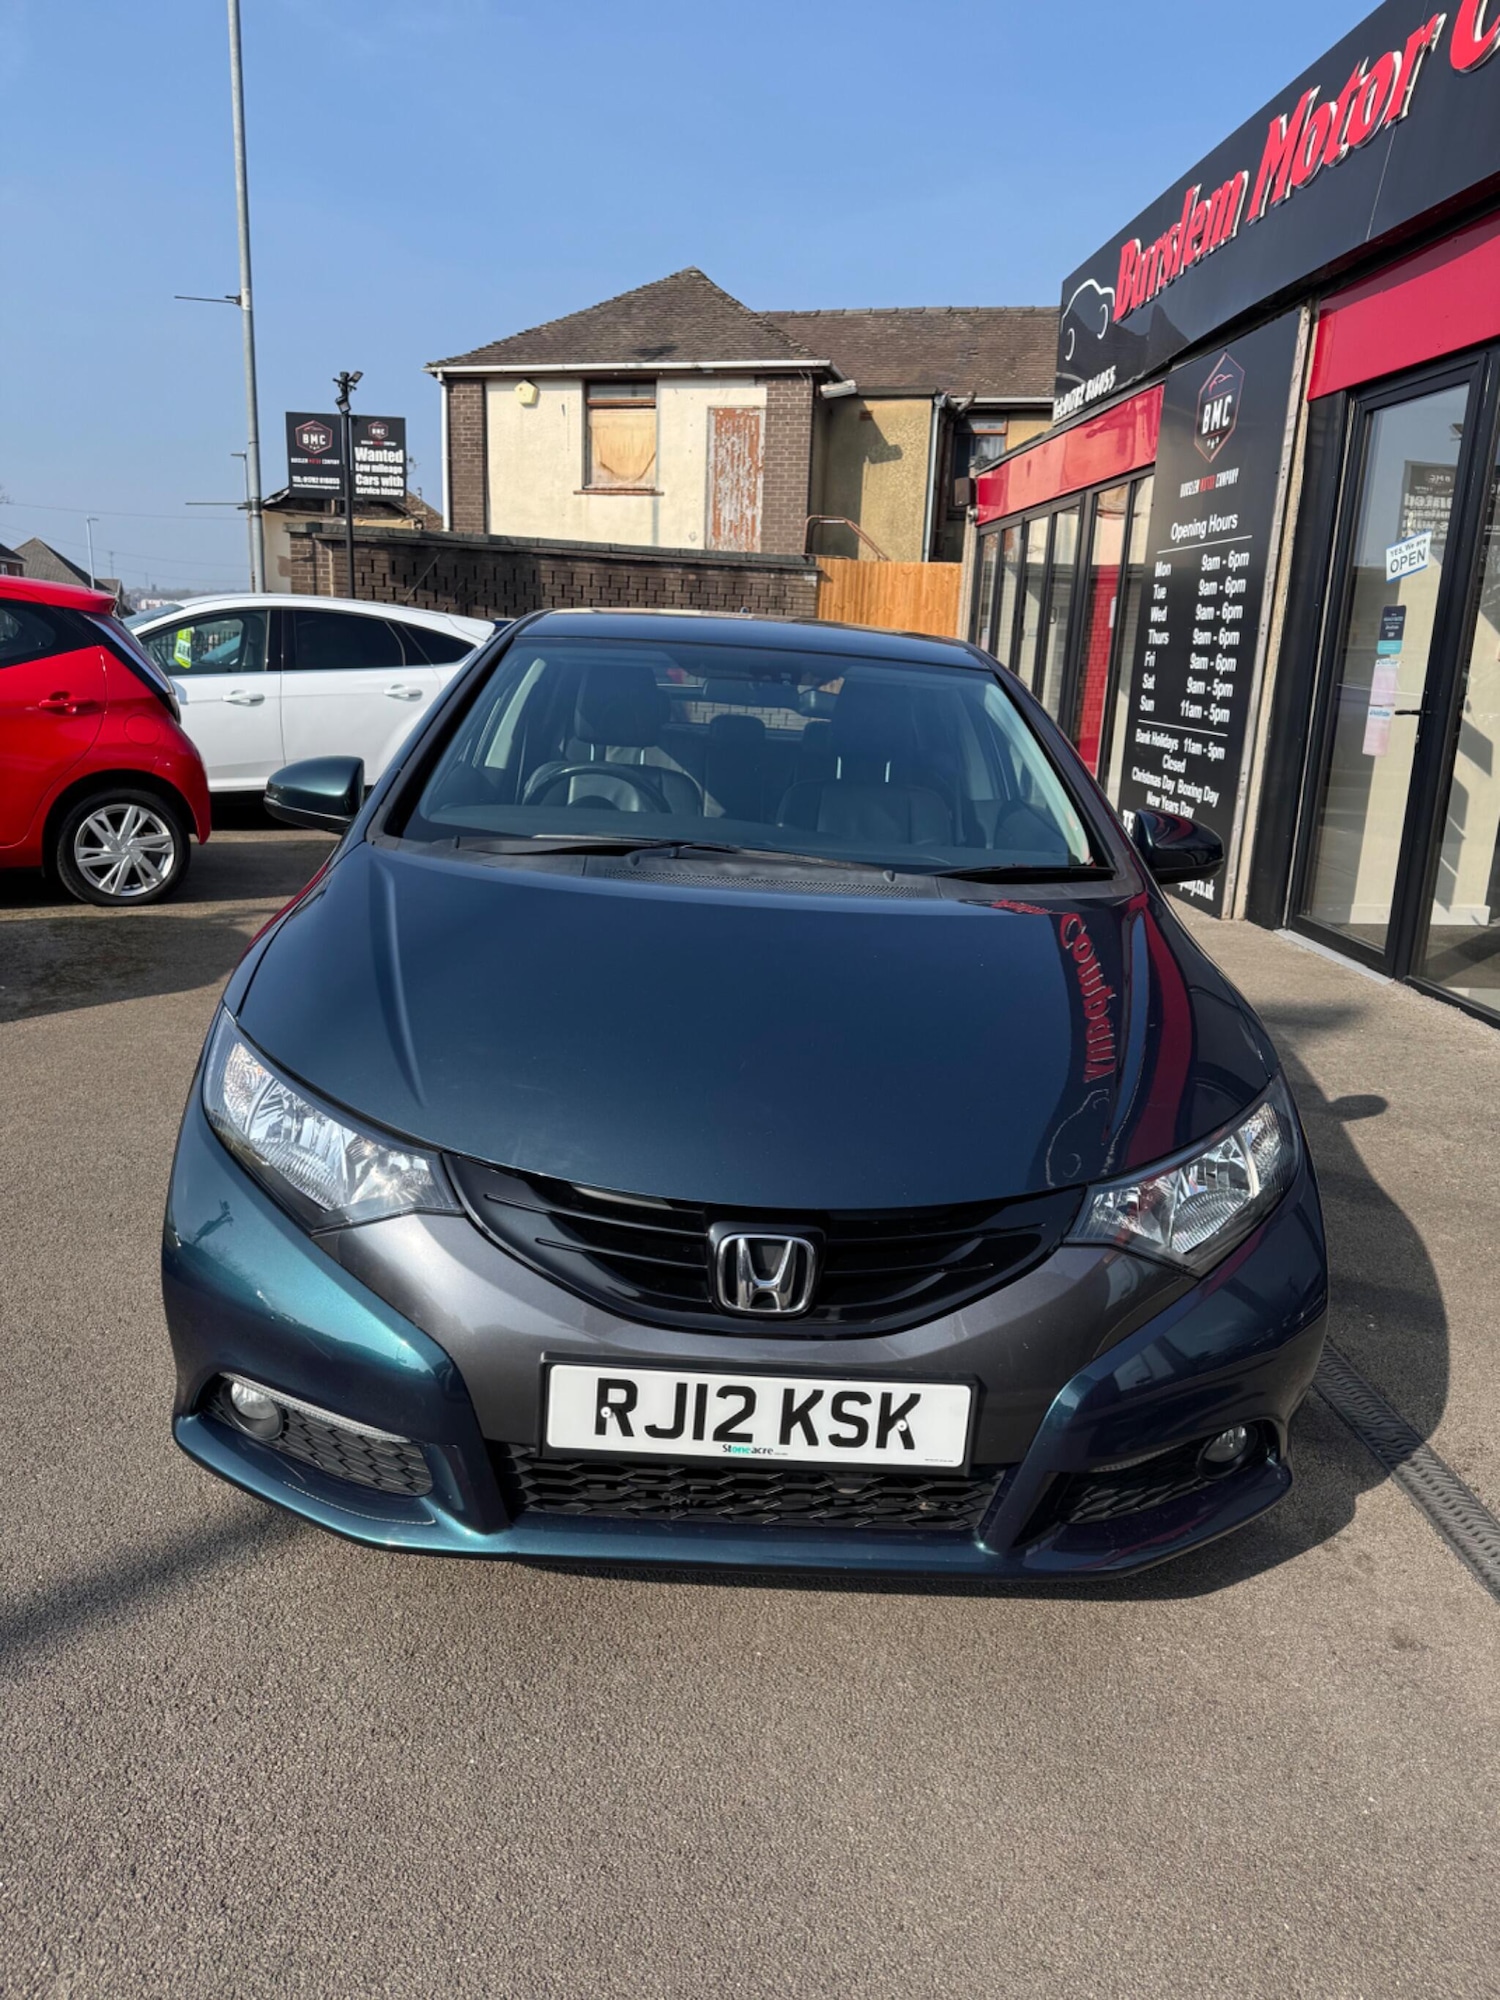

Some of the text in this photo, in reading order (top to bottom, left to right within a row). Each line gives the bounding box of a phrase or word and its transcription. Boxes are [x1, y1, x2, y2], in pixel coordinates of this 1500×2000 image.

[1113, 170, 1249, 323] Burslem
[1246, 13, 1446, 227] Motor
[1202, 394, 1233, 434] BMC
[302, 433, 326, 445] BMC
[354, 447, 404, 463] Wanted
[355, 462, 403, 474] Low mileage
[355, 474, 404, 487] Cars with
[381, 487, 404, 497] history
[1171, 513, 1238, 543] Opening Hours
[1154, 561, 1172, 577] Mon
[1201, 554, 1221, 571] 9am
[1228, 550, 1250, 572] 6pm
[1390, 548, 1427, 573] OPEN
[1153, 584, 1167, 600] Tue
[1198, 579, 1218, 596] 9am
[1224, 576, 1246, 598] 6pm
[1150, 606, 1168, 622] Wed
[1195, 604, 1215, 621] 9am
[1221, 601, 1243, 624] 6pm
[1148, 629, 1170, 645] Thurs
[1192, 628, 1212, 645] 9am
[1218, 627, 1240, 649] 6pm
[1144, 651, 1156, 667] Fri
[1190, 653, 1209, 670] 9am
[1215, 653, 1237, 675] 6pm
[1142, 673, 1155, 690] Sat
[1186, 676, 1206, 694] 9am
[1212, 678, 1233, 700] 5pm
[1139, 695, 1155, 712] Sun
[1180, 700, 1202, 718] 11am
[1209, 704, 1230, 725] 5pm
[1135, 728, 1151, 745] Bank
[1151, 731, 1179, 753] Holidays
[1184, 737, 1202, 755] 11am
[1207, 741, 1225, 761] 5pm
[1162, 754, 1186, 773] Closed
[1131, 766, 1220, 808] Christmas Day Boxing Day
[1146, 790, 1195, 819] New Years Day
[594, 1376, 922, 1450] RJ12 KSK
[722, 1443, 774, 1456] Stoneacre
